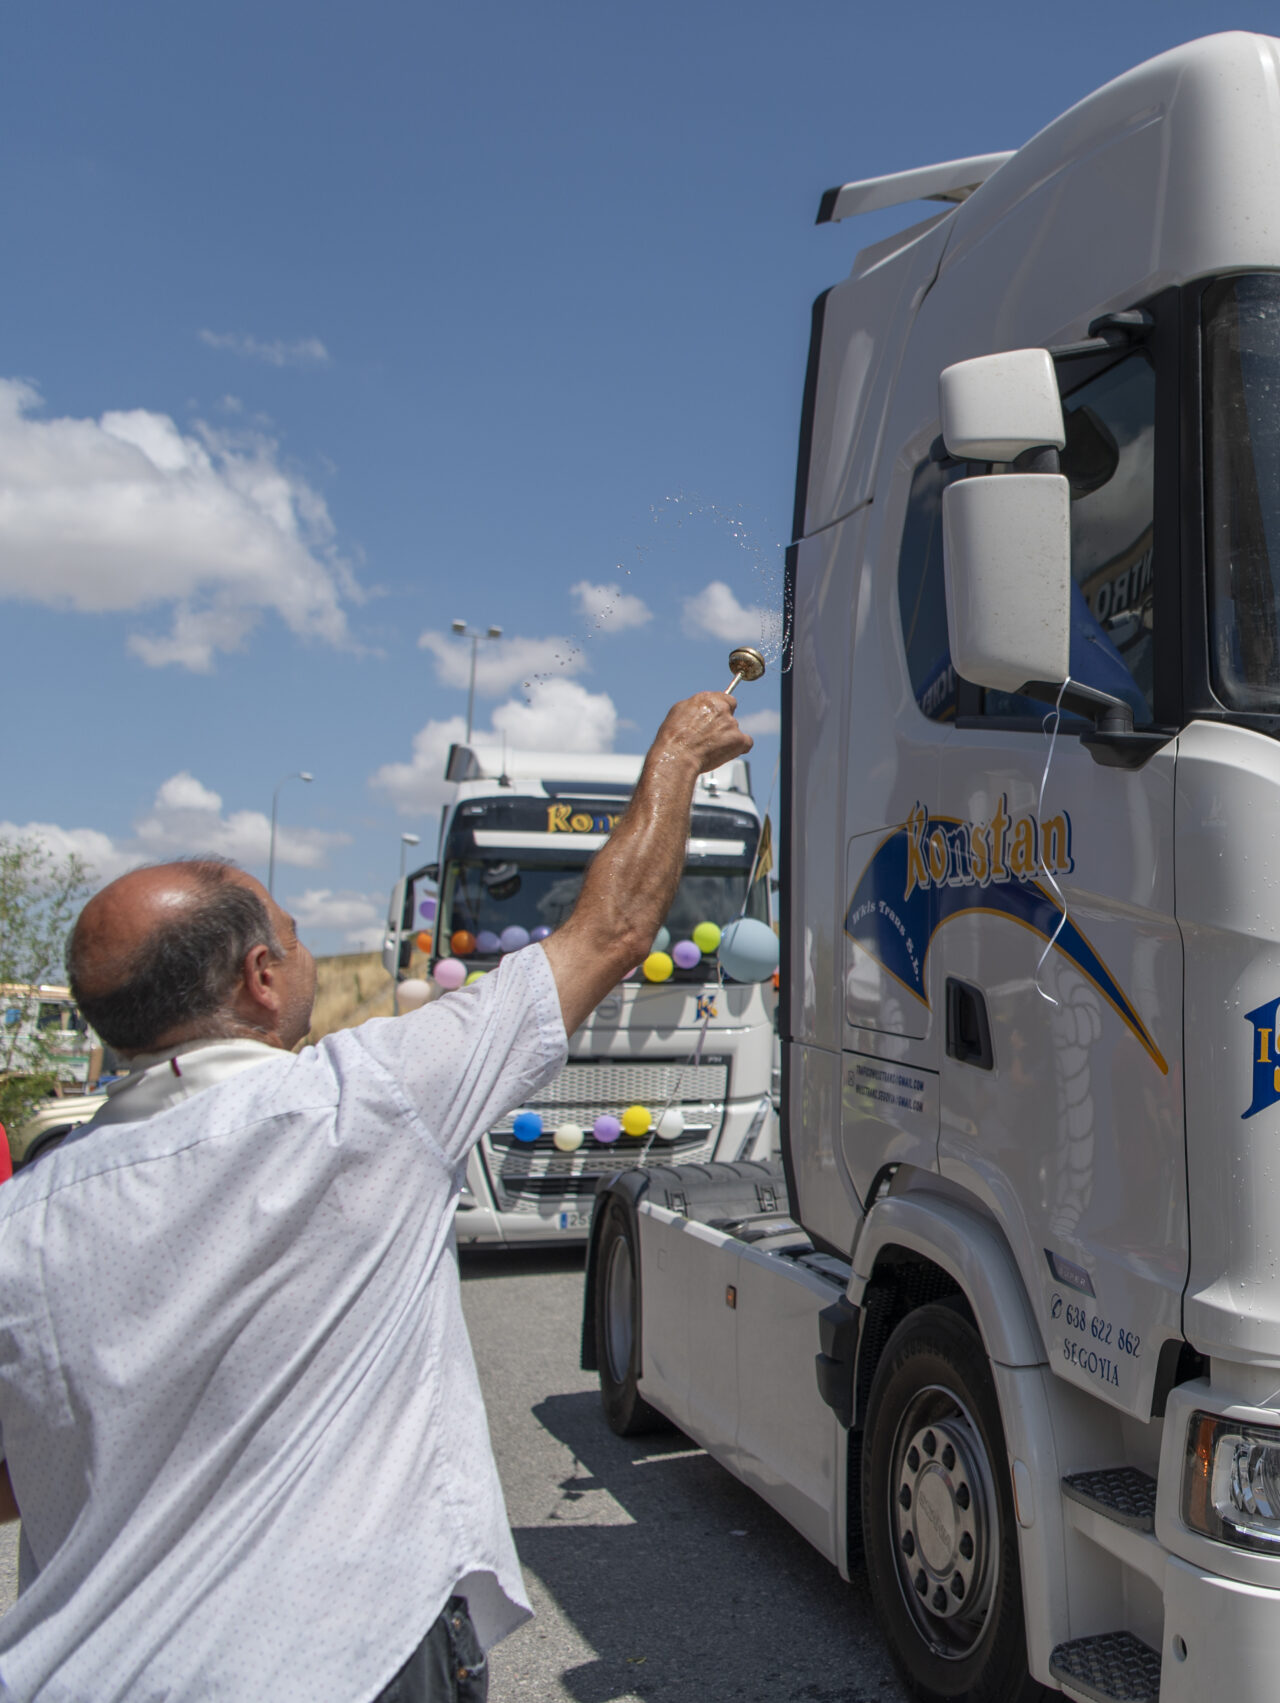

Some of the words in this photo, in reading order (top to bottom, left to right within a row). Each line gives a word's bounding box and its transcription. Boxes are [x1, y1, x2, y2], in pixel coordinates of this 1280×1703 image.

[547, 803, 621, 834] Kon
[904, 793, 1075, 902] Konstan
[878, 900, 906, 937] Trans
[1066, 1304, 1086, 1332] 638
[1091, 1316, 1112, 1345] 622
[1118, 1328, 1142, 1358] 862
